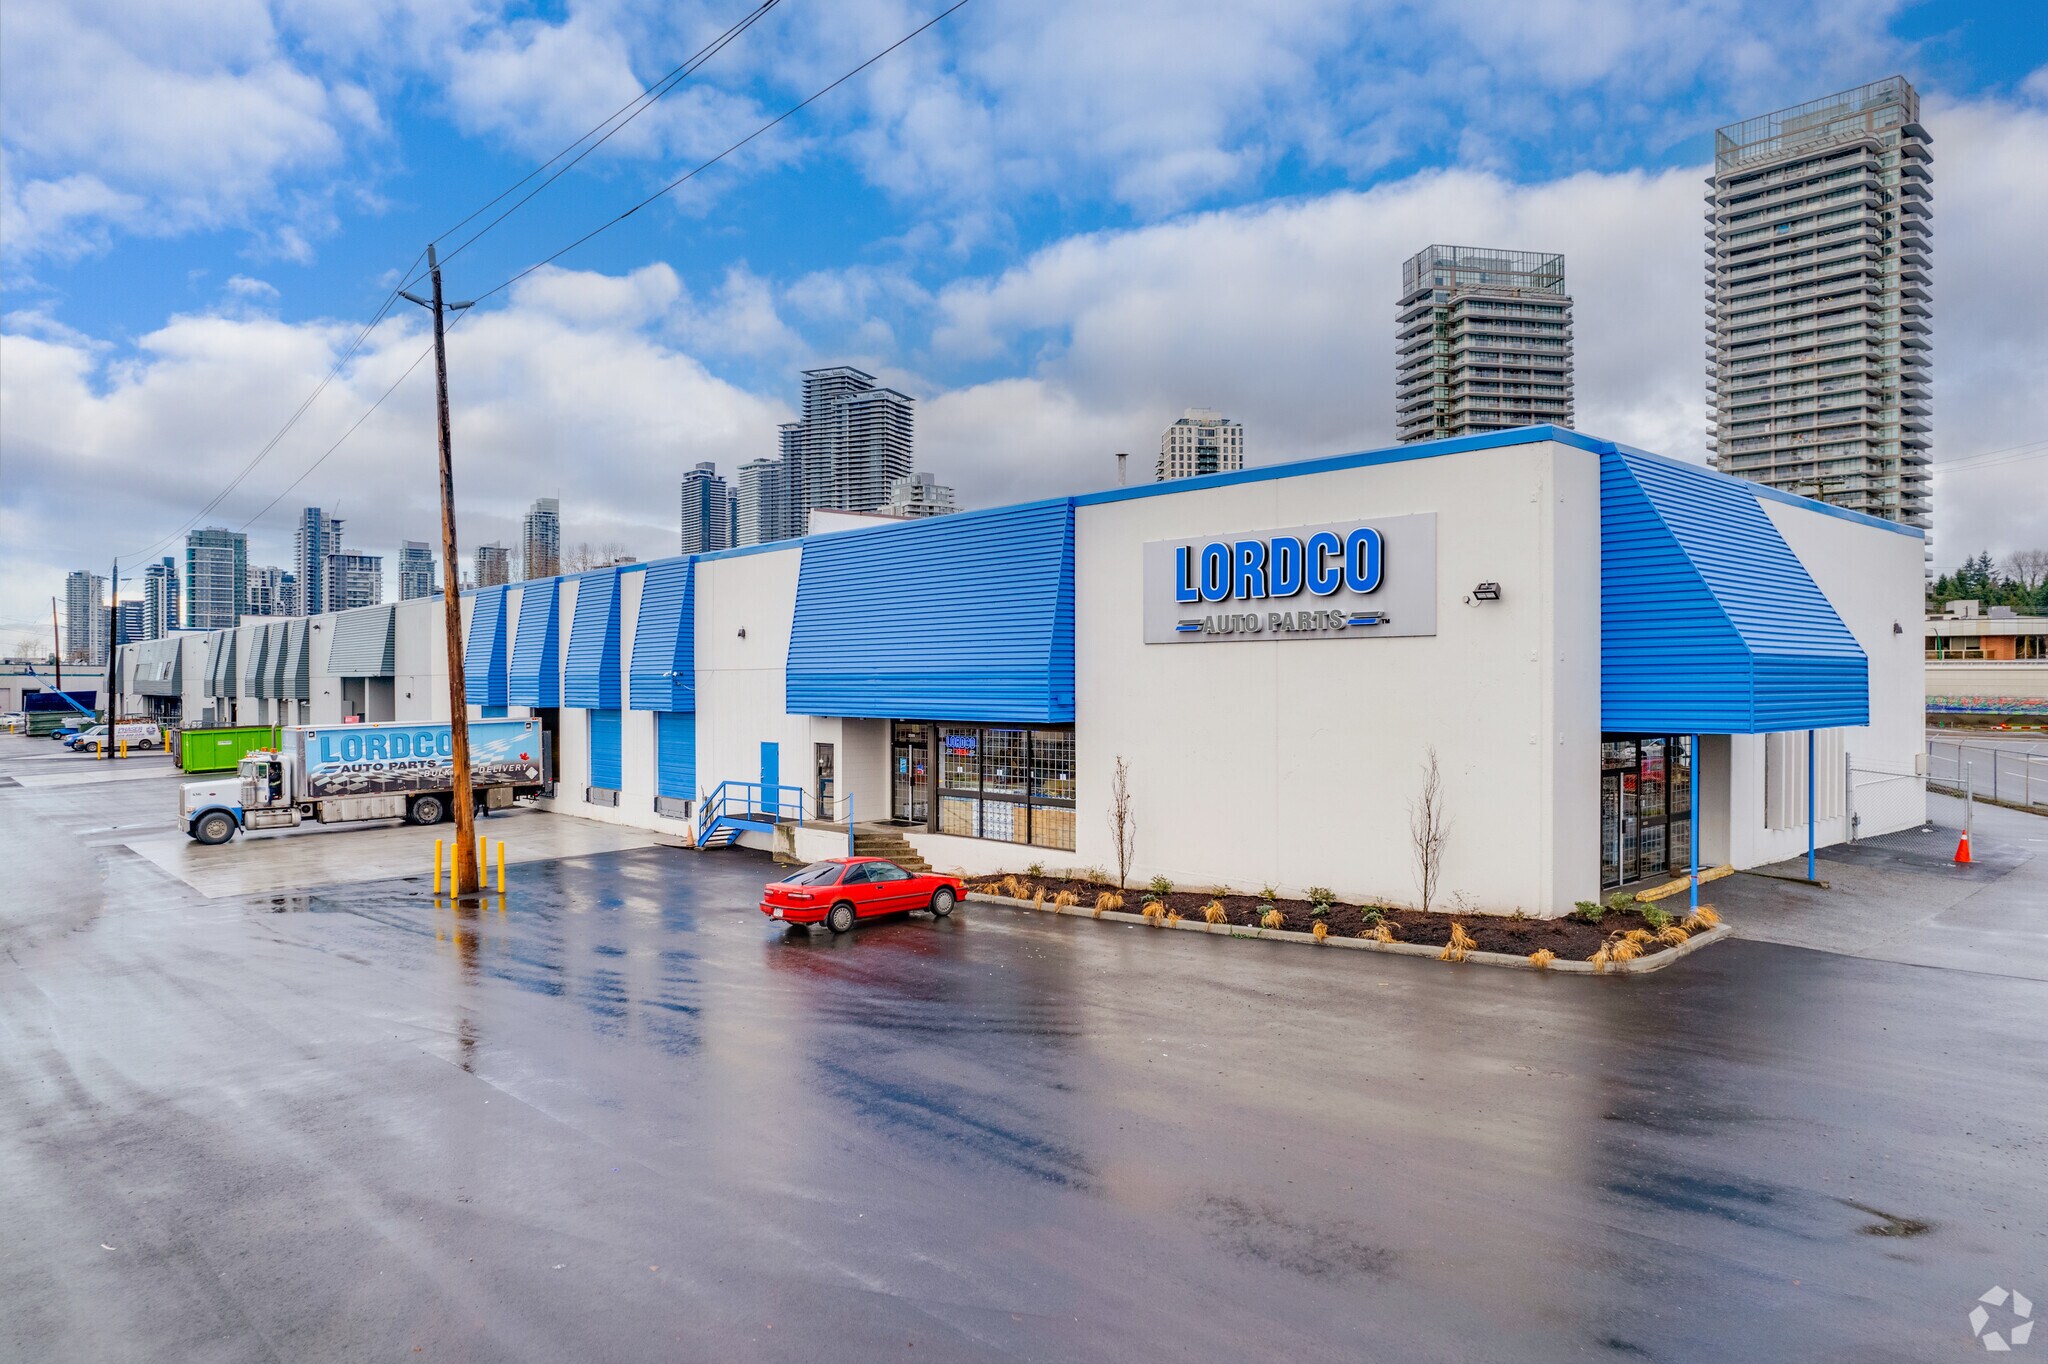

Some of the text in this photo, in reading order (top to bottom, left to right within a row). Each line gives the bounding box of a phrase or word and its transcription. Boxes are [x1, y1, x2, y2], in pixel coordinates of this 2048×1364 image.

[1174, 527, 1384, 603] LORDCO
[1203, 612, 1262, 634] AUTO
[1268, 609, 1347, 631] PARTS
[320, 731, 453, 763] LORDCO
[946, 735, 976, 749] LORDCO
[340, 759, 437, 773] AUTO PARTS
[424, 763, 529, 777] BULK DELIVERY
